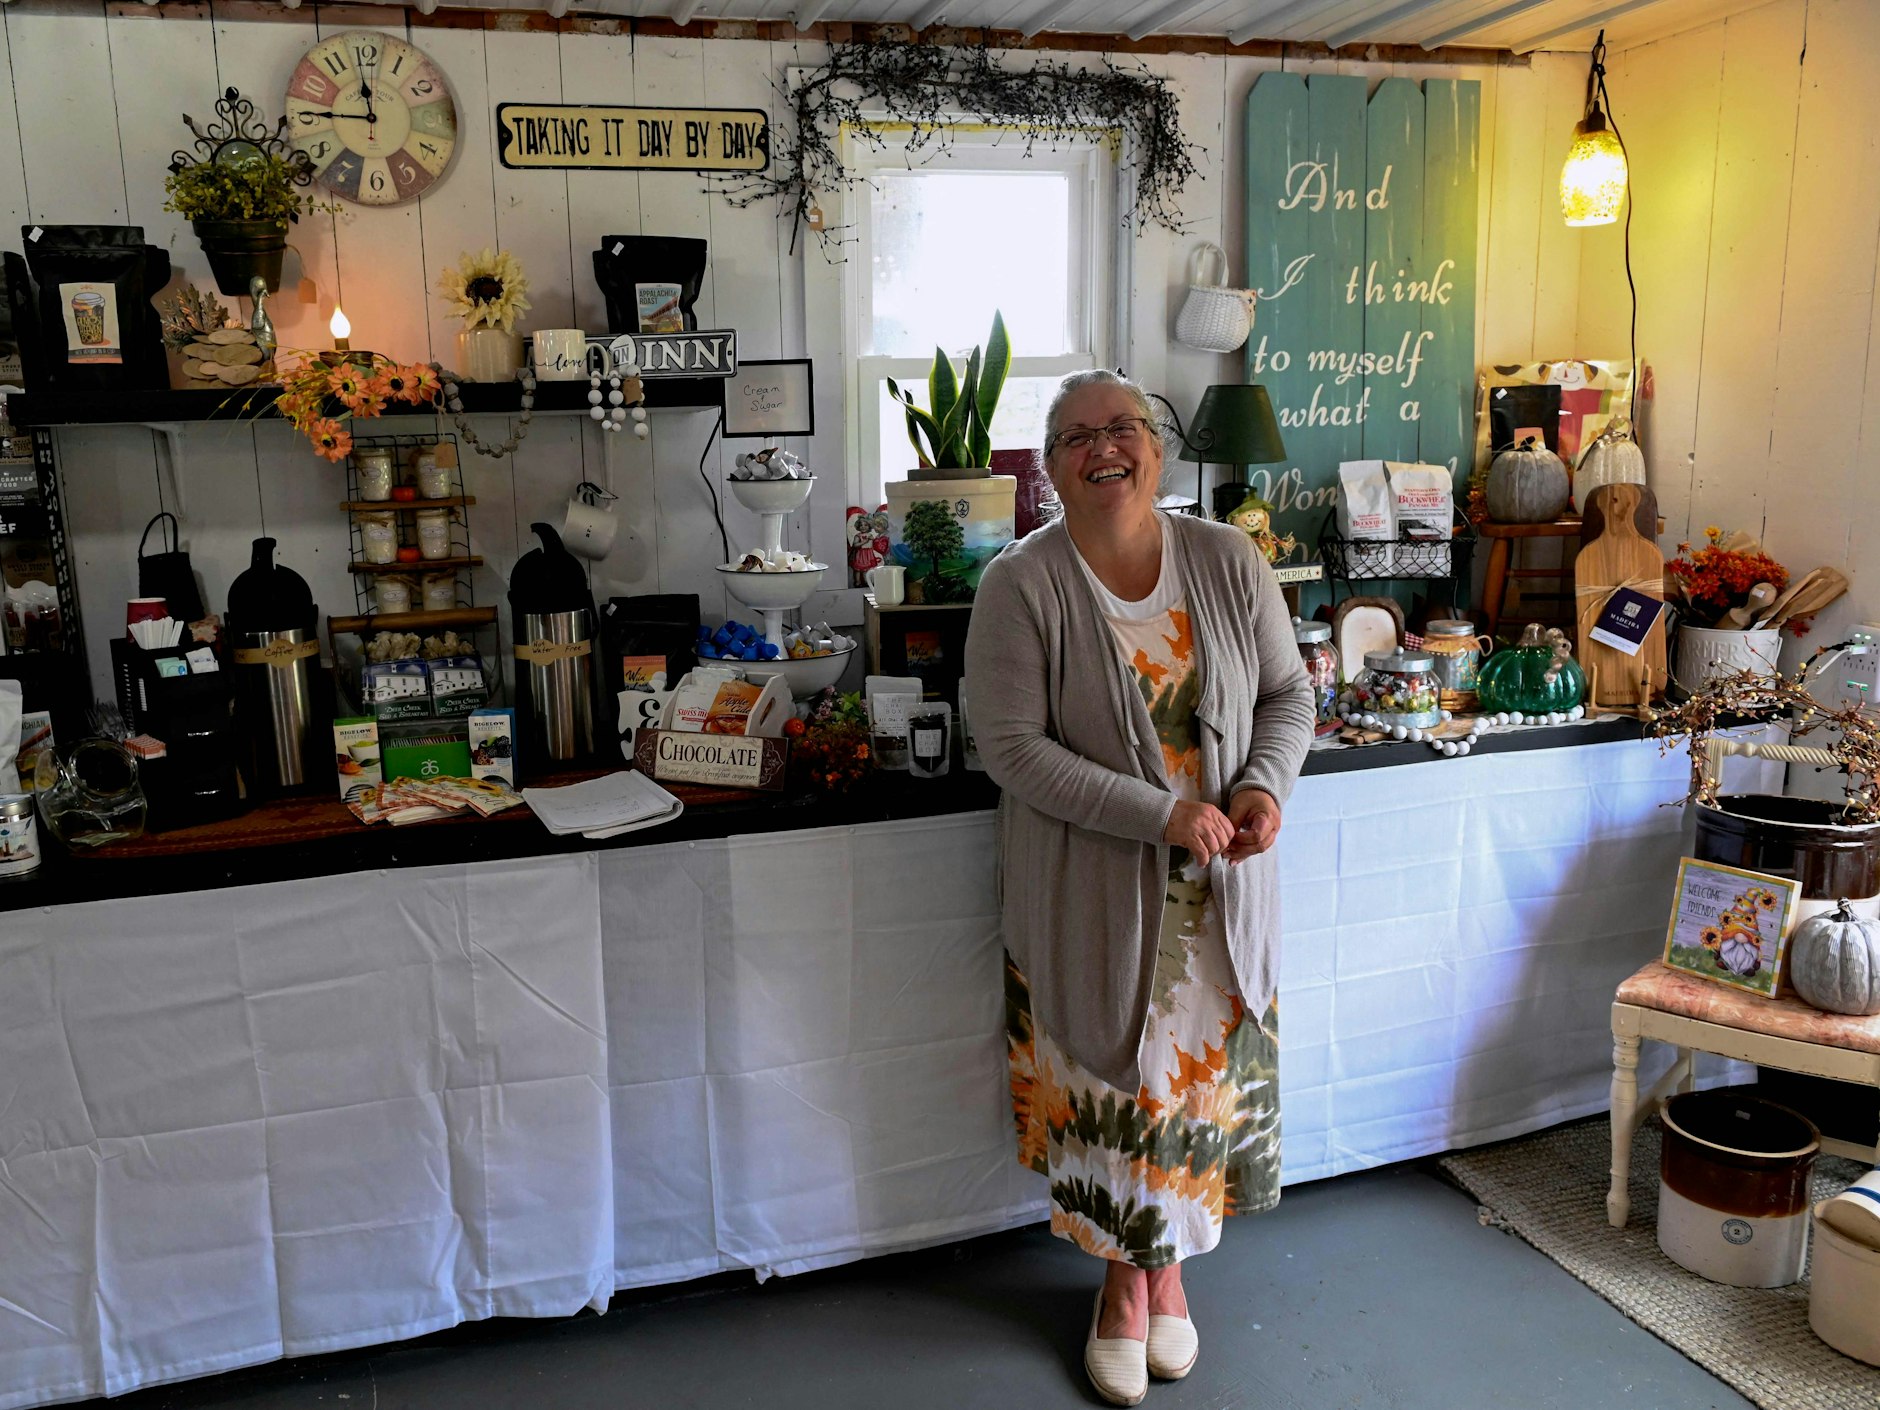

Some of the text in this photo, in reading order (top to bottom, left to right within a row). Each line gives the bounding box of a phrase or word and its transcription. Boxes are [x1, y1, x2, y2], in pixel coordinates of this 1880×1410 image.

[324, 52, 349, 76] 11
[353, 45, 378, 67] 12
[391, 55, 404, 76] 1
[303, 75, 327, 98] 10
[411, 79, 433, 97] 2
[512, 117, 756, 159] TAKING IT DAY BY DAY
[309, 141, 331, 159] 8
[418, 141, 438, 160] 4
[337, 160, 355, 183] 7
[369, 170, 385, 191] 6
[399, 161, 416, 185] 5
[1278, 161, 1392, 212] And
[1257, 253, 1455, 305] I think
[639, 289, 678, 298] APPALACHIAN
[639, 297, 658, 305] ROAST
[613, 347, 630, 365] ON
[641, 338, 724, 371] INN
[1253, 330, 1434, 388] to myself
[743, 384, 780, 397] Cream
[750, 400, 783, 412] Sugar
[1279, 383, 1421, 428] what a
[958, 502, 967, 514] 2
[1276, 568, 1312, 580] AMERICA
[1610, 612, 1640, 630] MADEIRA
[264, 644, 293, 658] Coffee
[565, 645, 582, 653] Free
[719, 696, 749, 706] Apple
[731, 705, 751, 714] Cide
[340, 728, 372, 736] BIGELOW
[659, 736, 757, 767] CHOCOLATE
[1687, 883, 1721, 902] WELCOME
[1687, 900, 1716, 918] FRIENDS
[1734, 1228, 1742, 1236] 2
